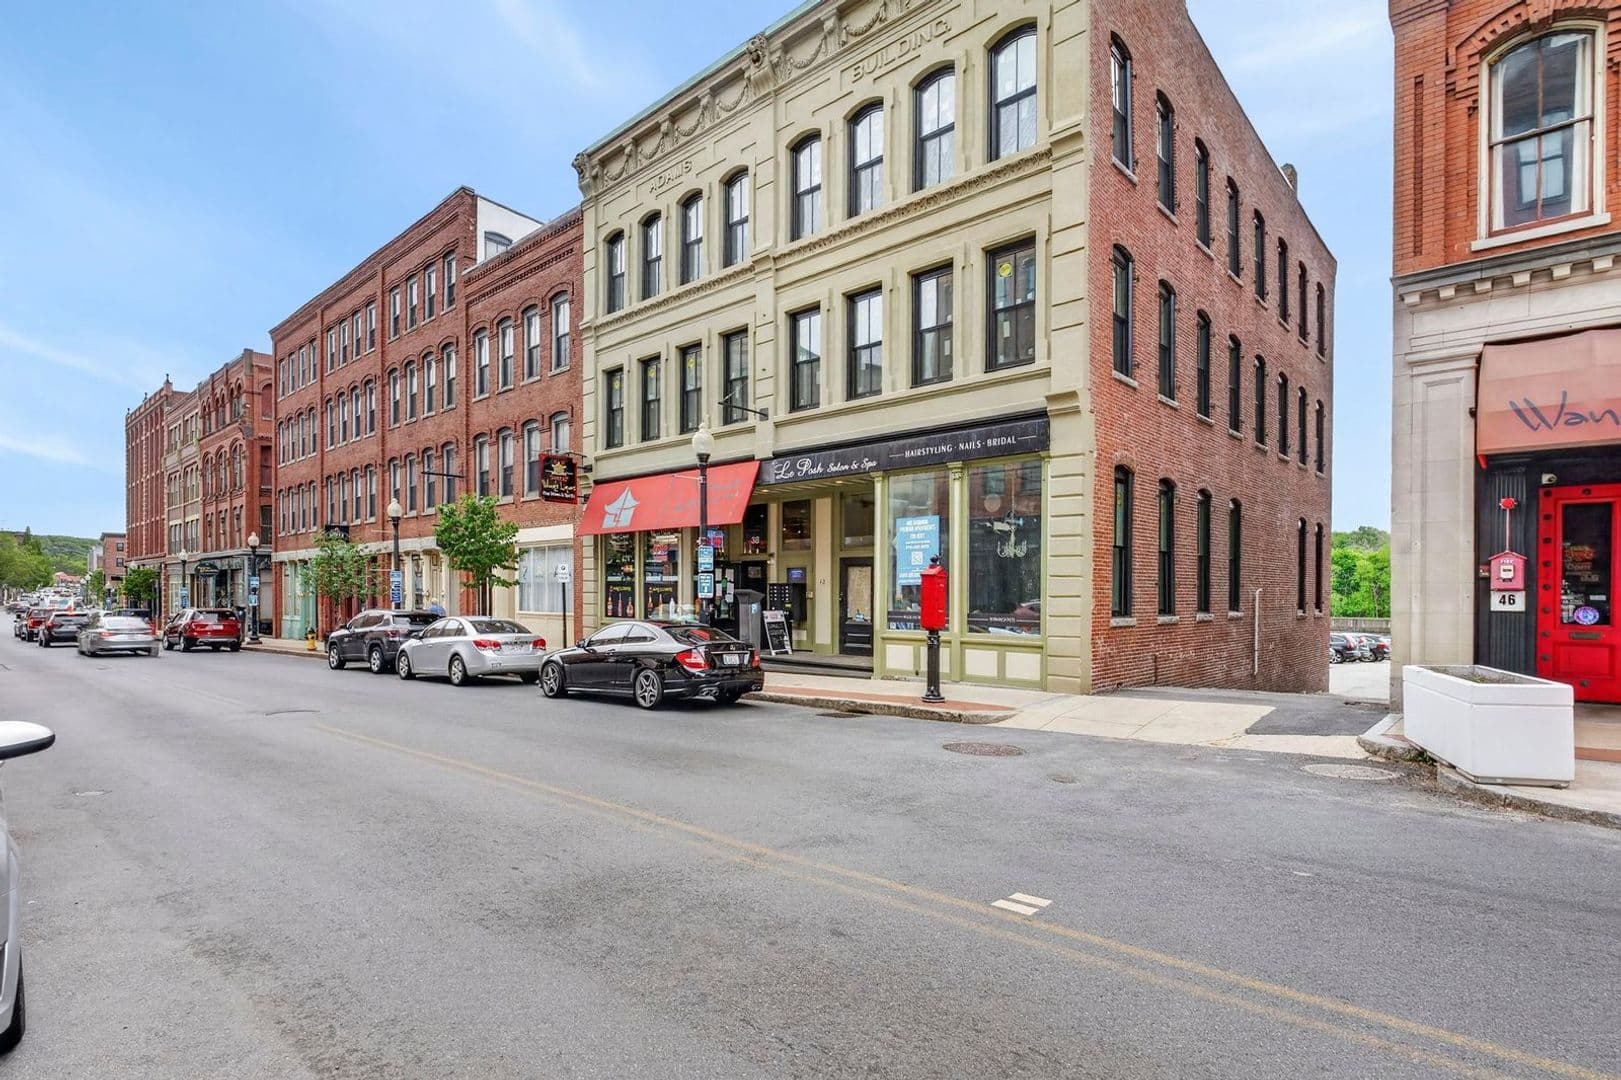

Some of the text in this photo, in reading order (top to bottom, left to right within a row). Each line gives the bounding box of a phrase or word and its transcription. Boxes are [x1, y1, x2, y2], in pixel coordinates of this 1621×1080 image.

[851, 19, 951, 84] BUILDING
[648, 160, 693, 194] ADAMS
[904, 435, 1017, 459] HAIRSTYLING NAILS BRIDAL
[773, 457, 878, 480] Le Posh Salon & Spa
[1498, 593, 1516, 606] 46
